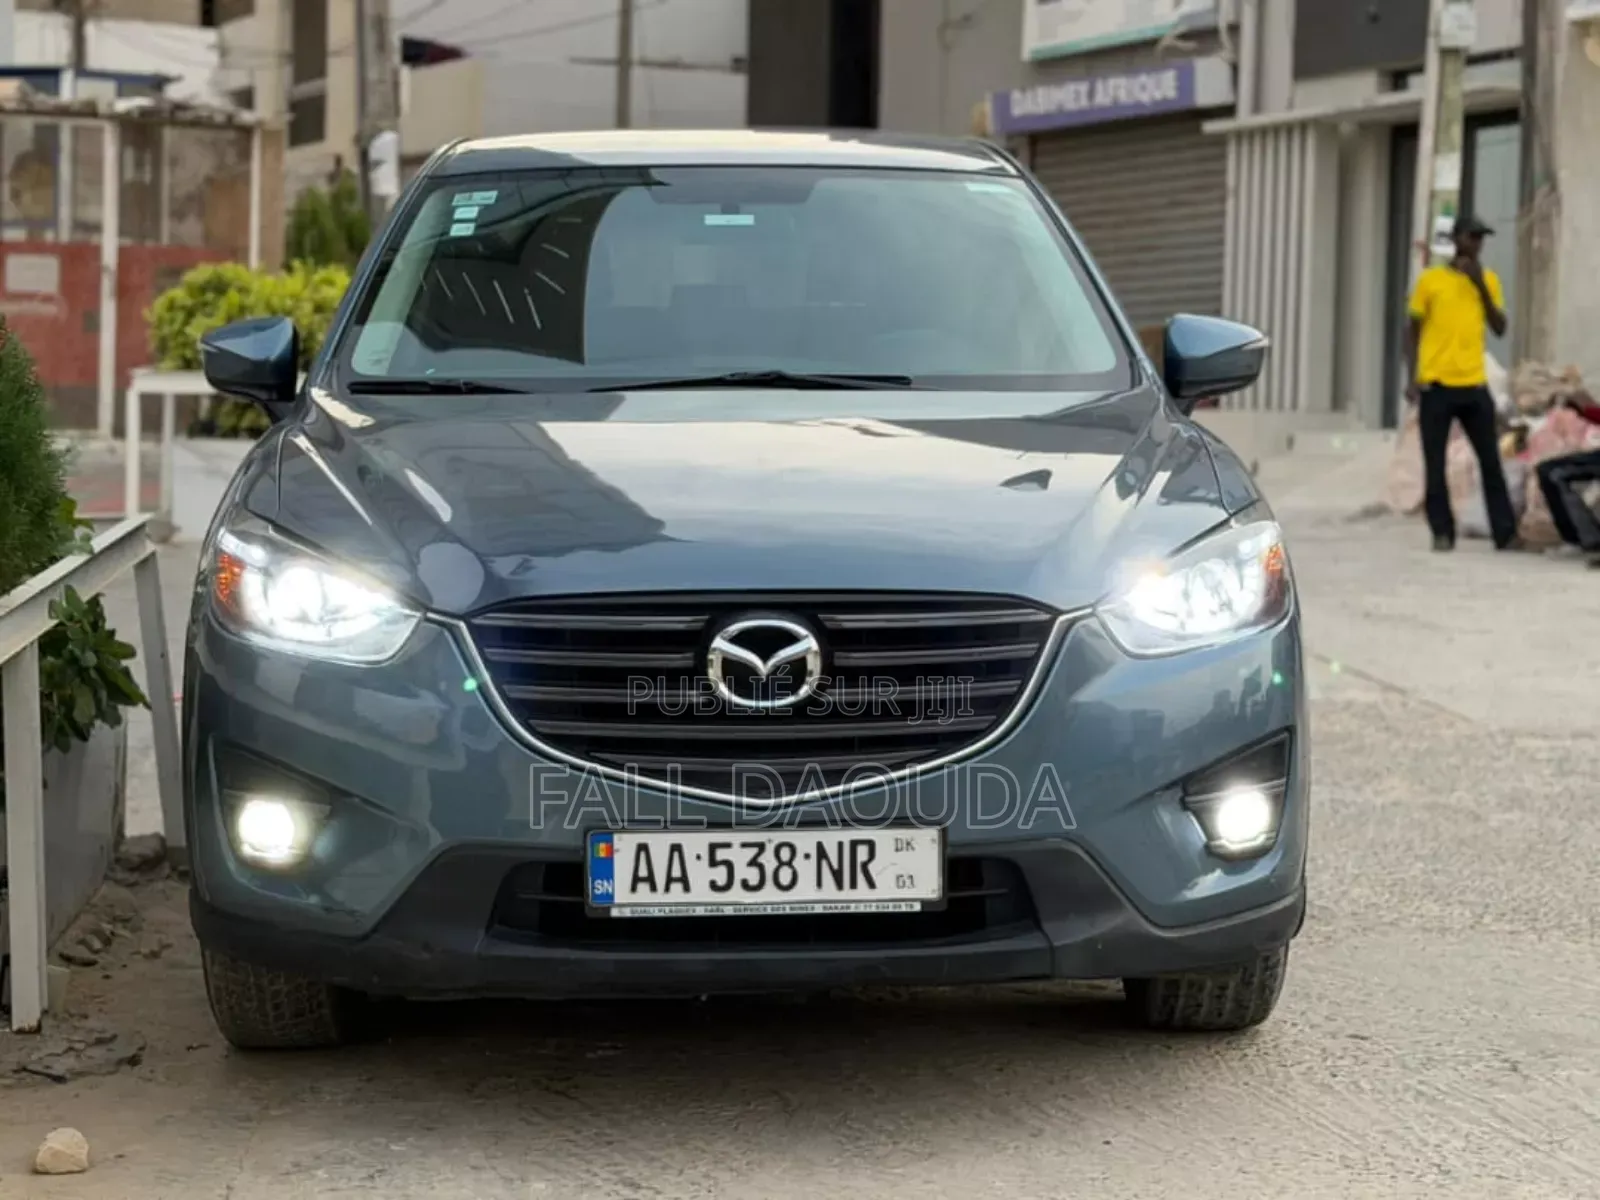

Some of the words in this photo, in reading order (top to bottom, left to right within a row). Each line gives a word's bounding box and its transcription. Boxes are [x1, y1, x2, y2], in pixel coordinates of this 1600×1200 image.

[1094, 68, 1177, 107] AFRIQUE
[894, 837, 915, 852] DK
[593, 879, 613, 893] SN
